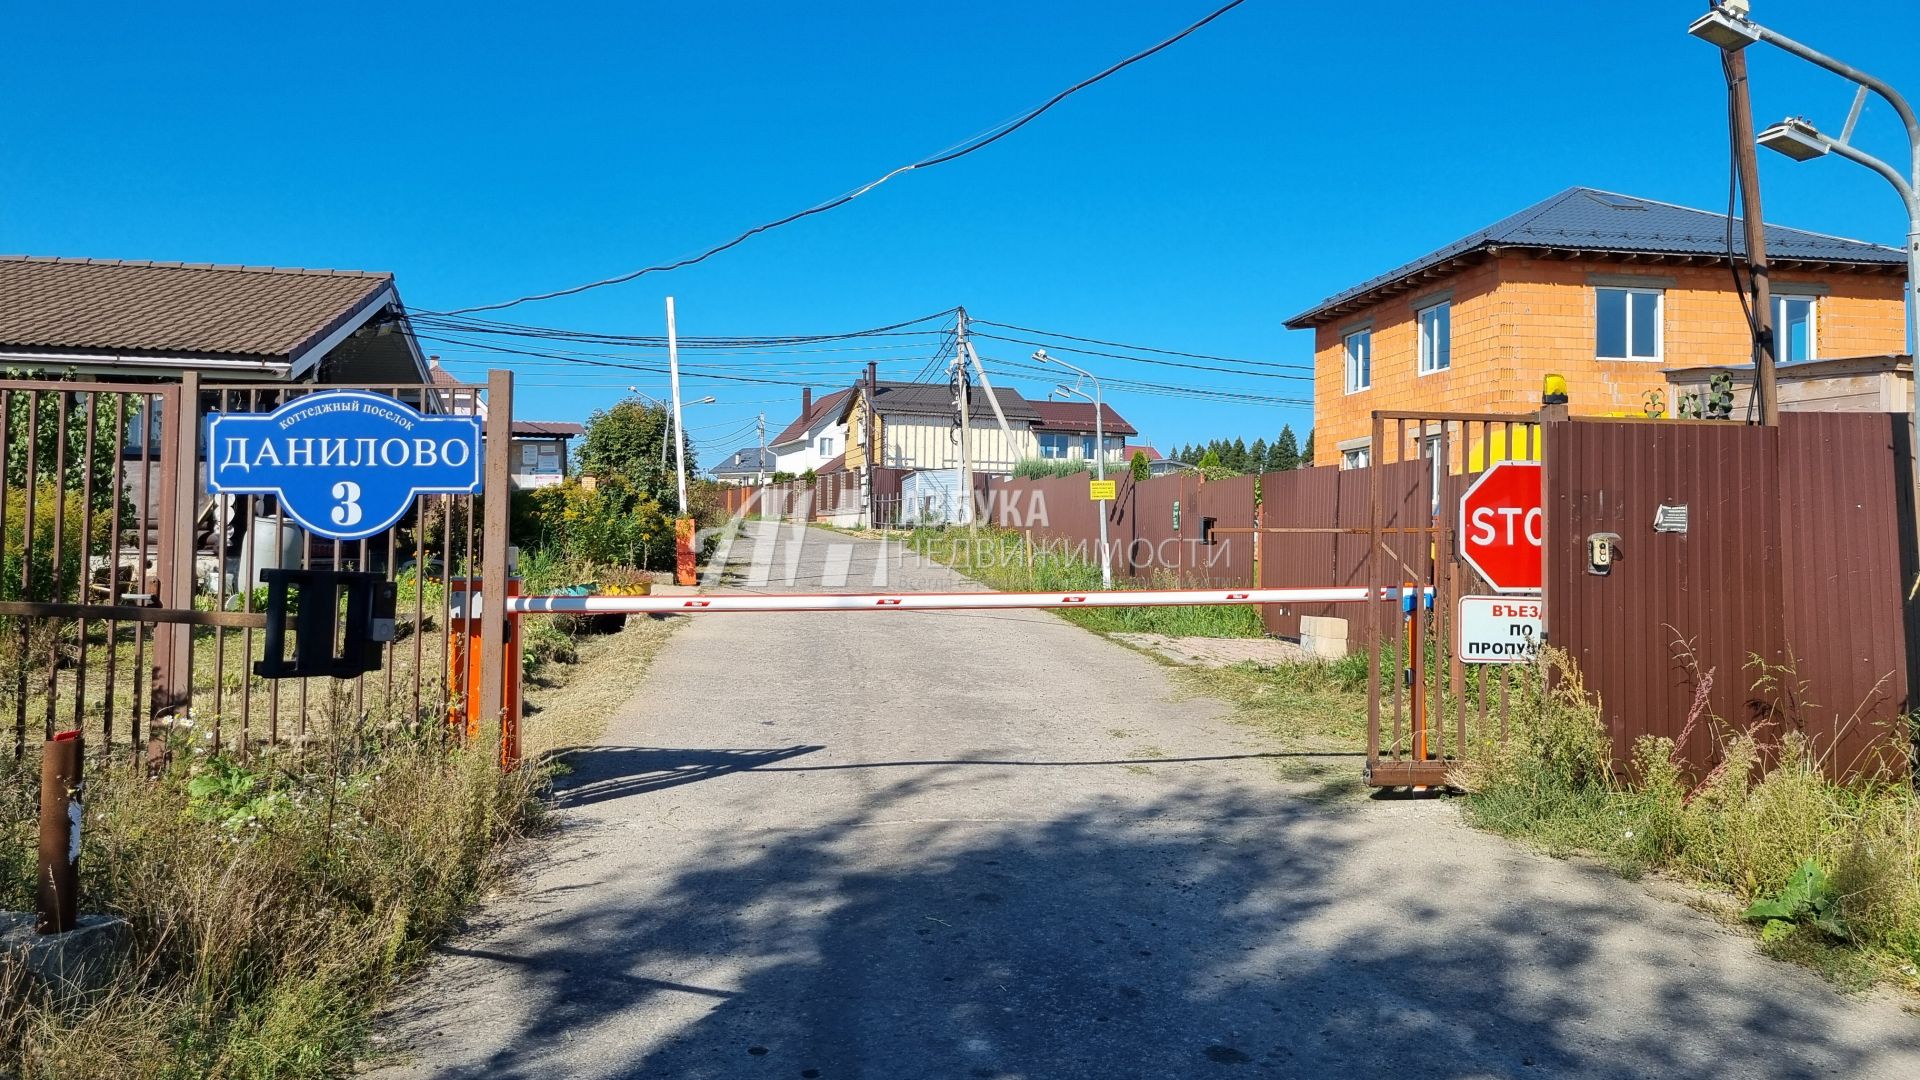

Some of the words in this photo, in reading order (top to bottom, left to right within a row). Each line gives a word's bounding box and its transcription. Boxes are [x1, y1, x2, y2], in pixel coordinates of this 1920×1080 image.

[280, 401, 360, 430] коттеджный
[363, 404, 415, 431] поселок
[221, 437, 470, 472] ДАНИЛОВО
[331, 481, 363, 525] 3
[1470, 507, 1542, 546] STO
[1510, 624, 1533, 636] ПО
[1469, 643, 1541, 655] ПРОПУ
